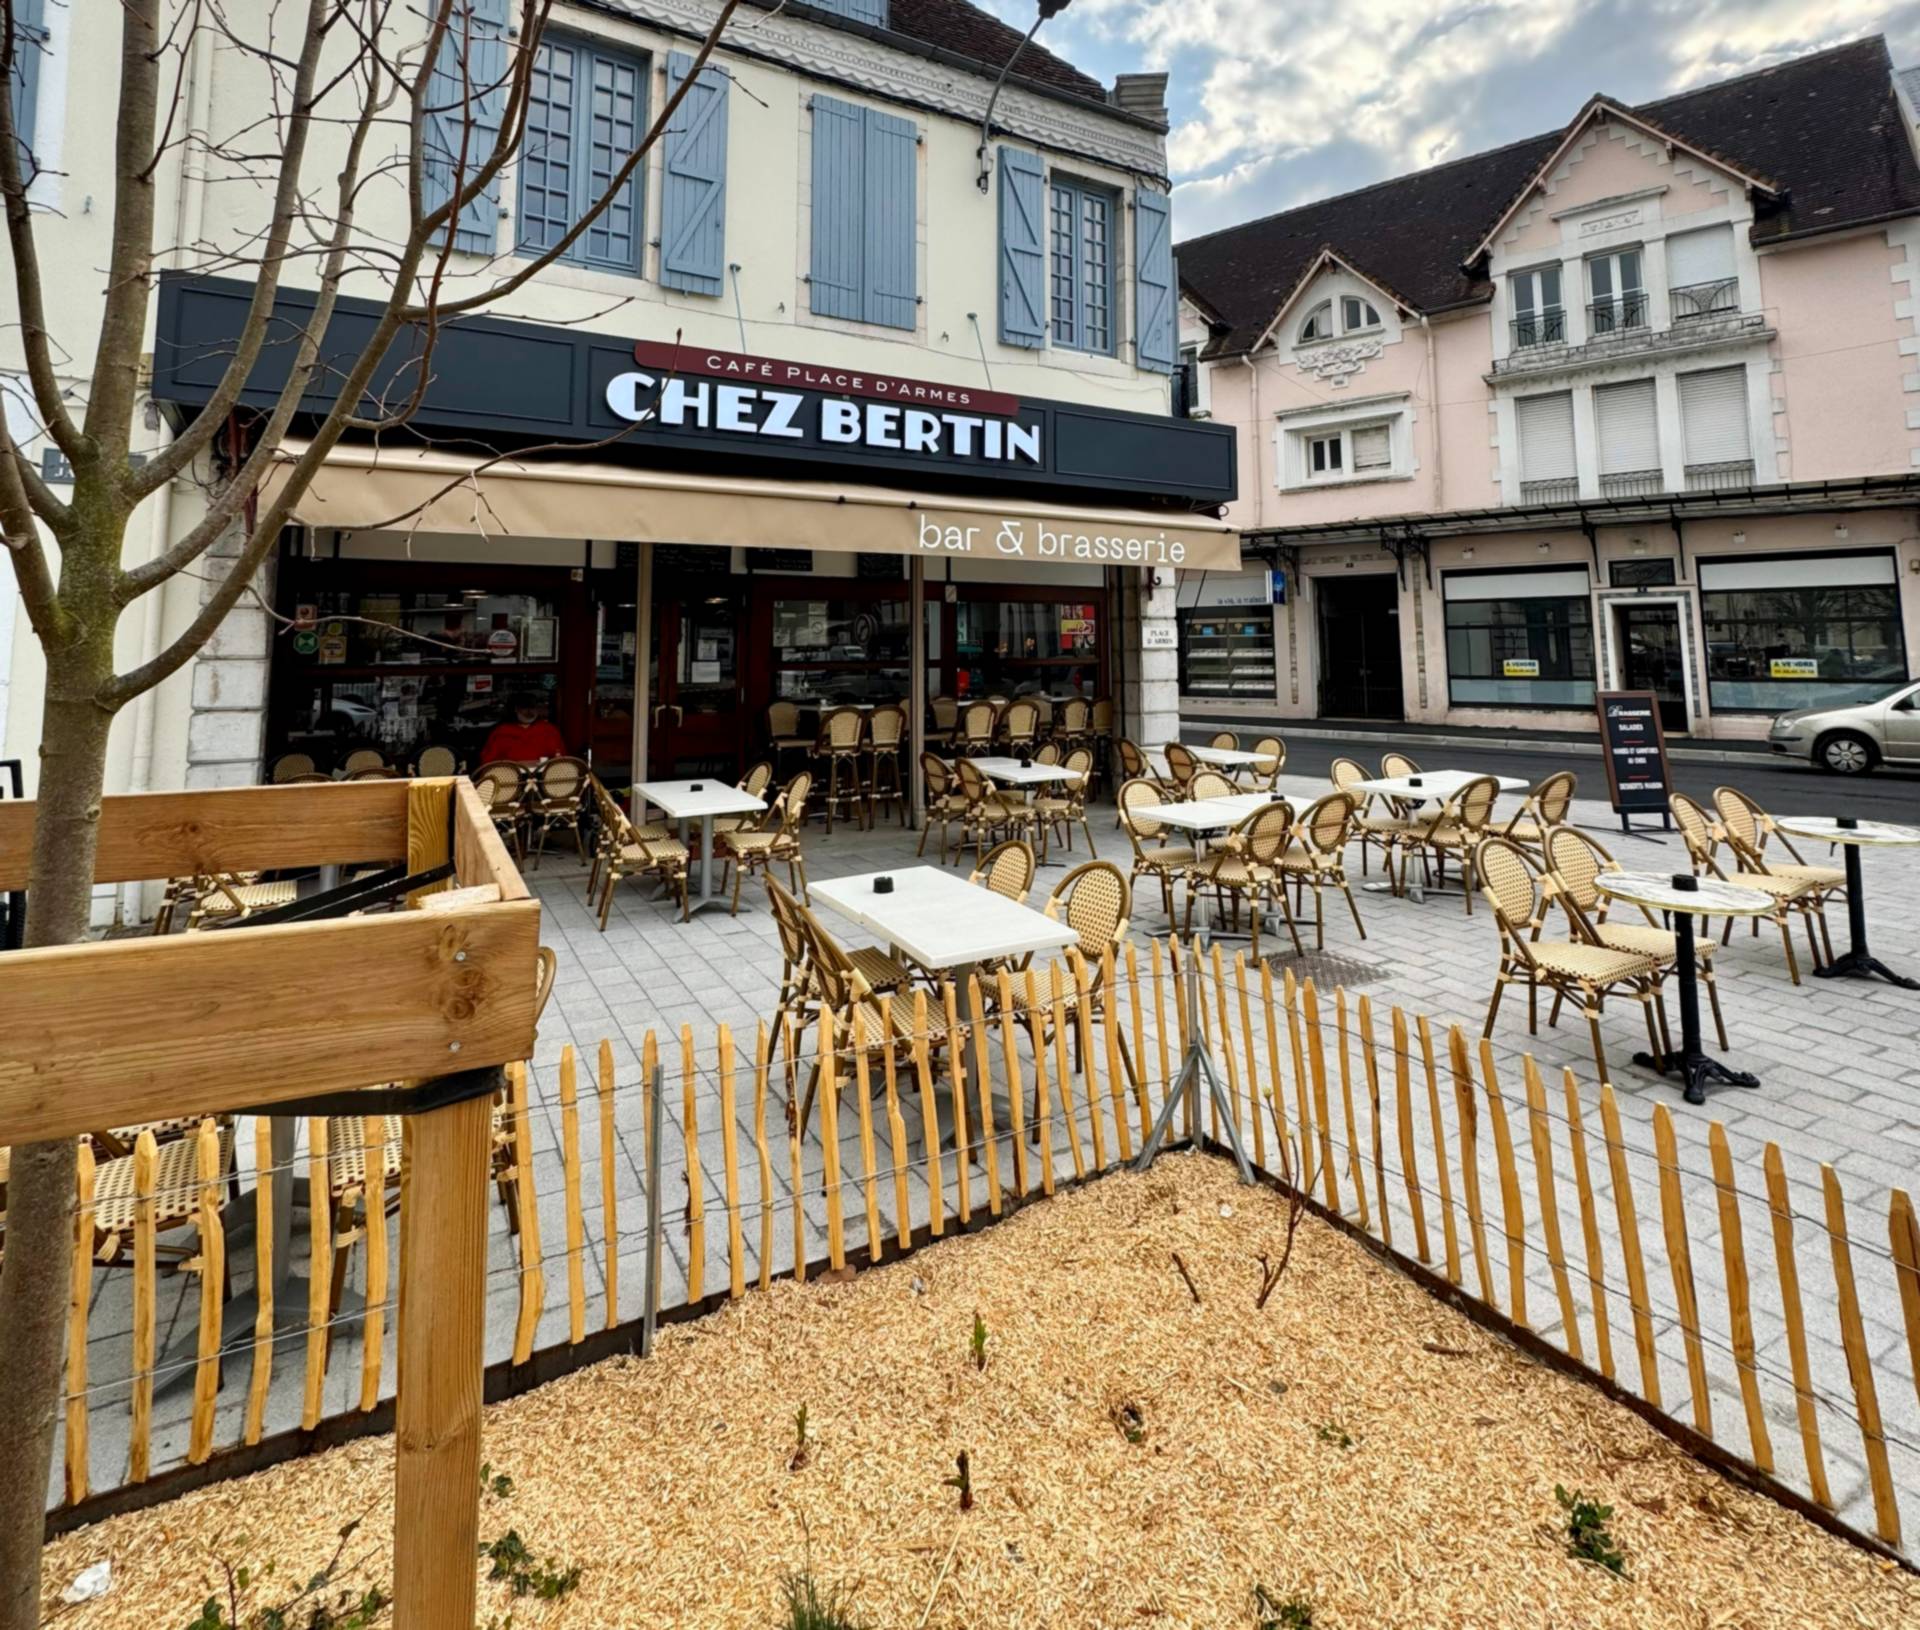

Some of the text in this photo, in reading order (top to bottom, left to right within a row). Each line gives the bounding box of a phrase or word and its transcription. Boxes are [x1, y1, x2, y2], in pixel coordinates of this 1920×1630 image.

[706, 355, 971, 404] CAFÉ PLACE D'ARMES
[605, 371, 1040, 464] CHEZ BERTIN
[918, 513, 1186, 563] bar & brasserie
